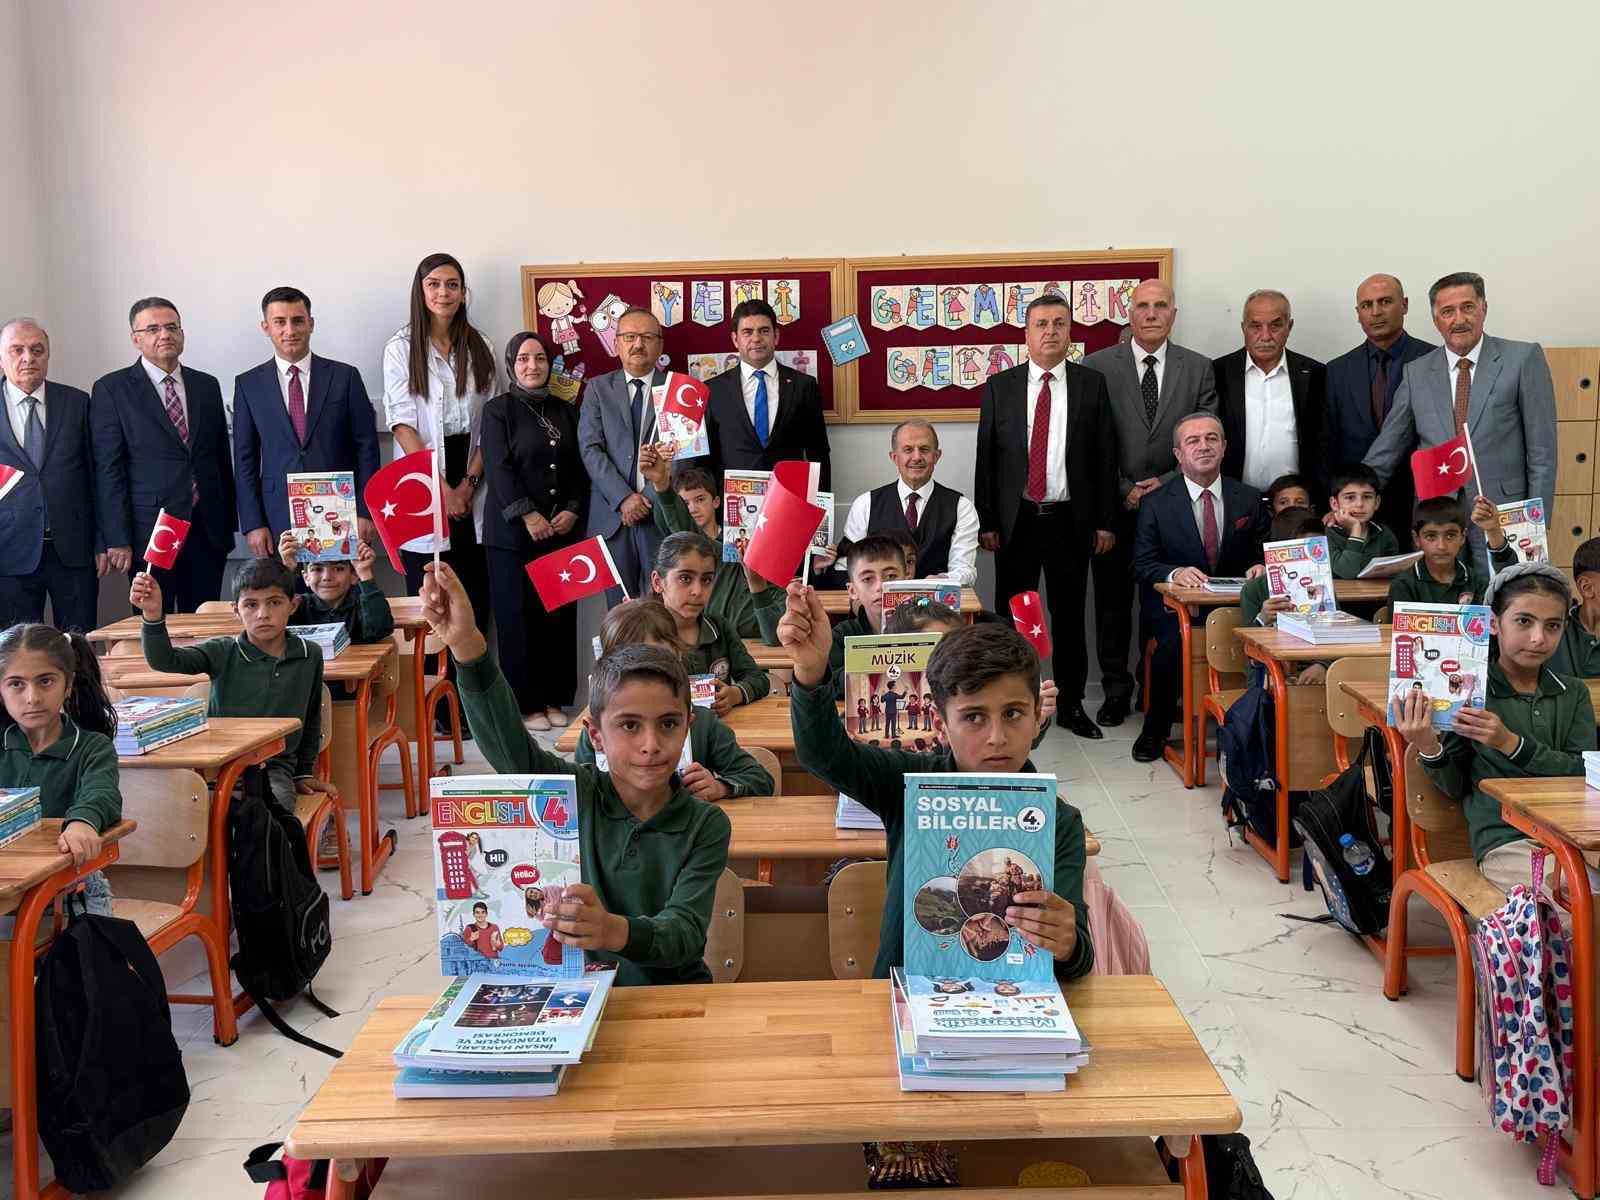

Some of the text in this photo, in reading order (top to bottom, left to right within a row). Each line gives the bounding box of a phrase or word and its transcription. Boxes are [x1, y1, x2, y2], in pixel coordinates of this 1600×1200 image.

[1397, 614, 1485, 636] ENGLISH 4
[871, 649, 917, 666] MÜZİK
[437, 799, 526, 825] ENGLISH
[542, 795, 569, 828] 4
[917, 796, 1002, 813] SOSYAL
[917, 812, 1017, 831] BİLGİLER
[489, 852, 505, 863] Hi!
[513, 867, 537, 879] Hello!
